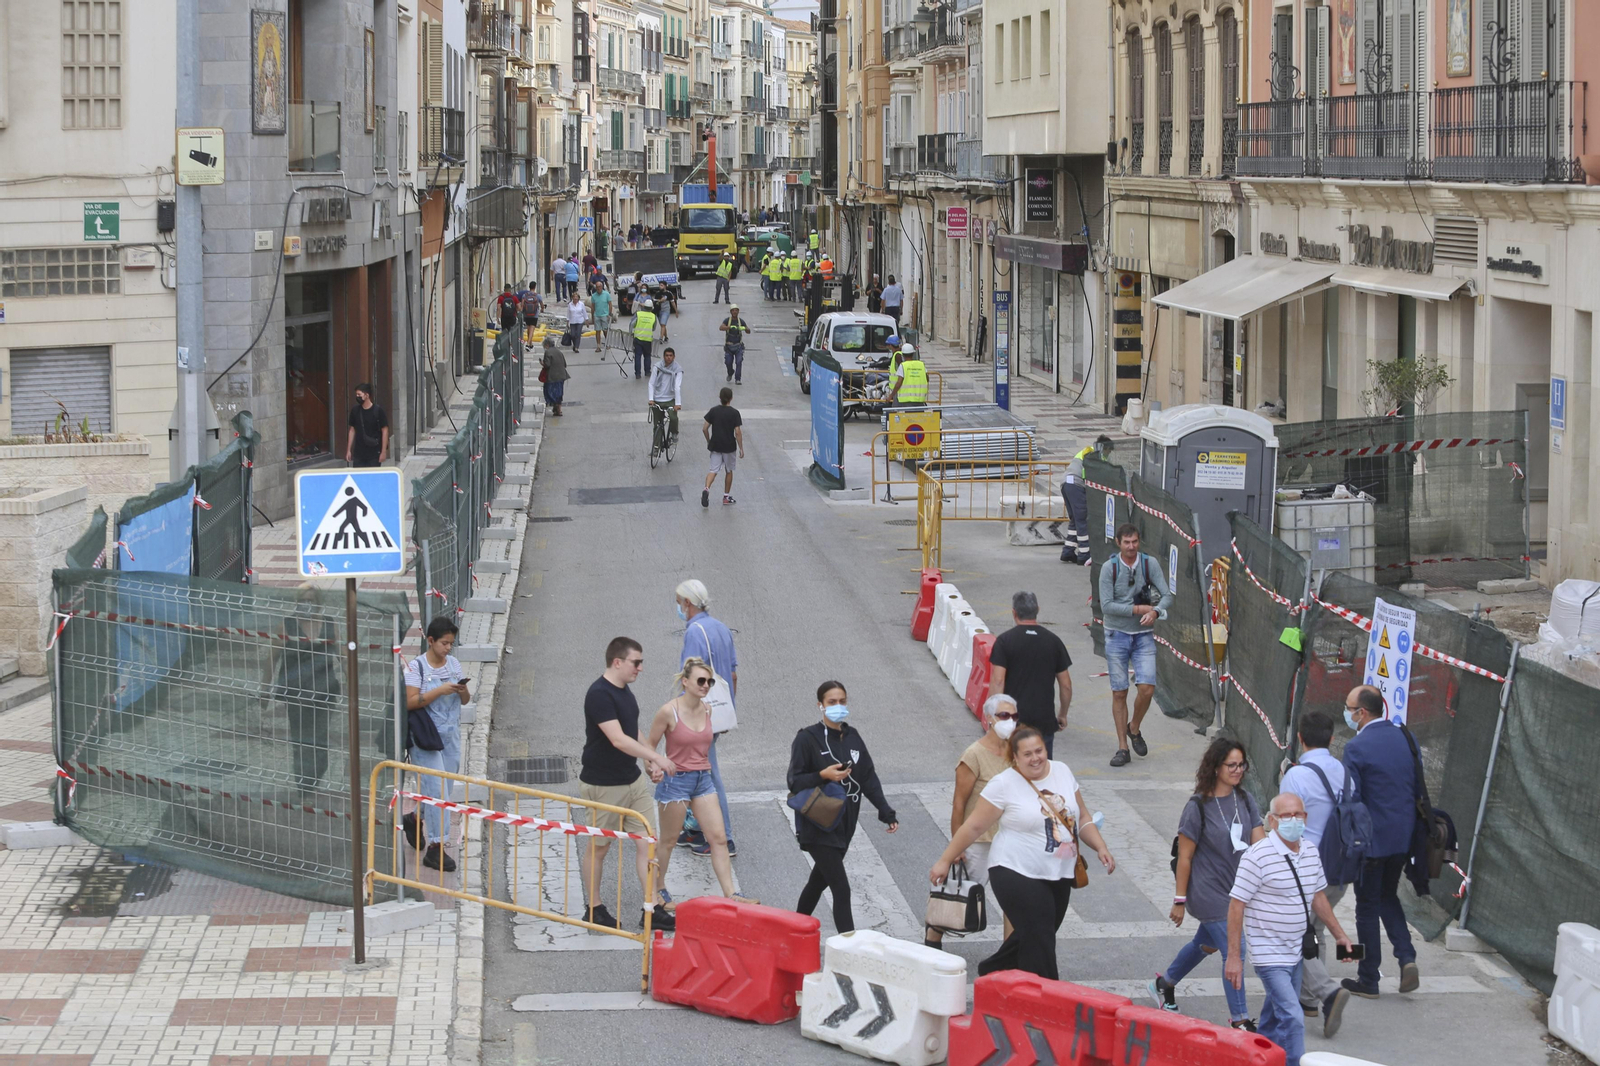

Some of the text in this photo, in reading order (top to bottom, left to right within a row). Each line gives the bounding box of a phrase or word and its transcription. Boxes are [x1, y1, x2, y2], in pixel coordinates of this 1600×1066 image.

[996, 293, 1008, 302] BUS
[1553, 382, 1562, 406] H
[1400, 611, 1412, 620] TODAS
[1389, 617, 1408, 628] SEGURIDAD
